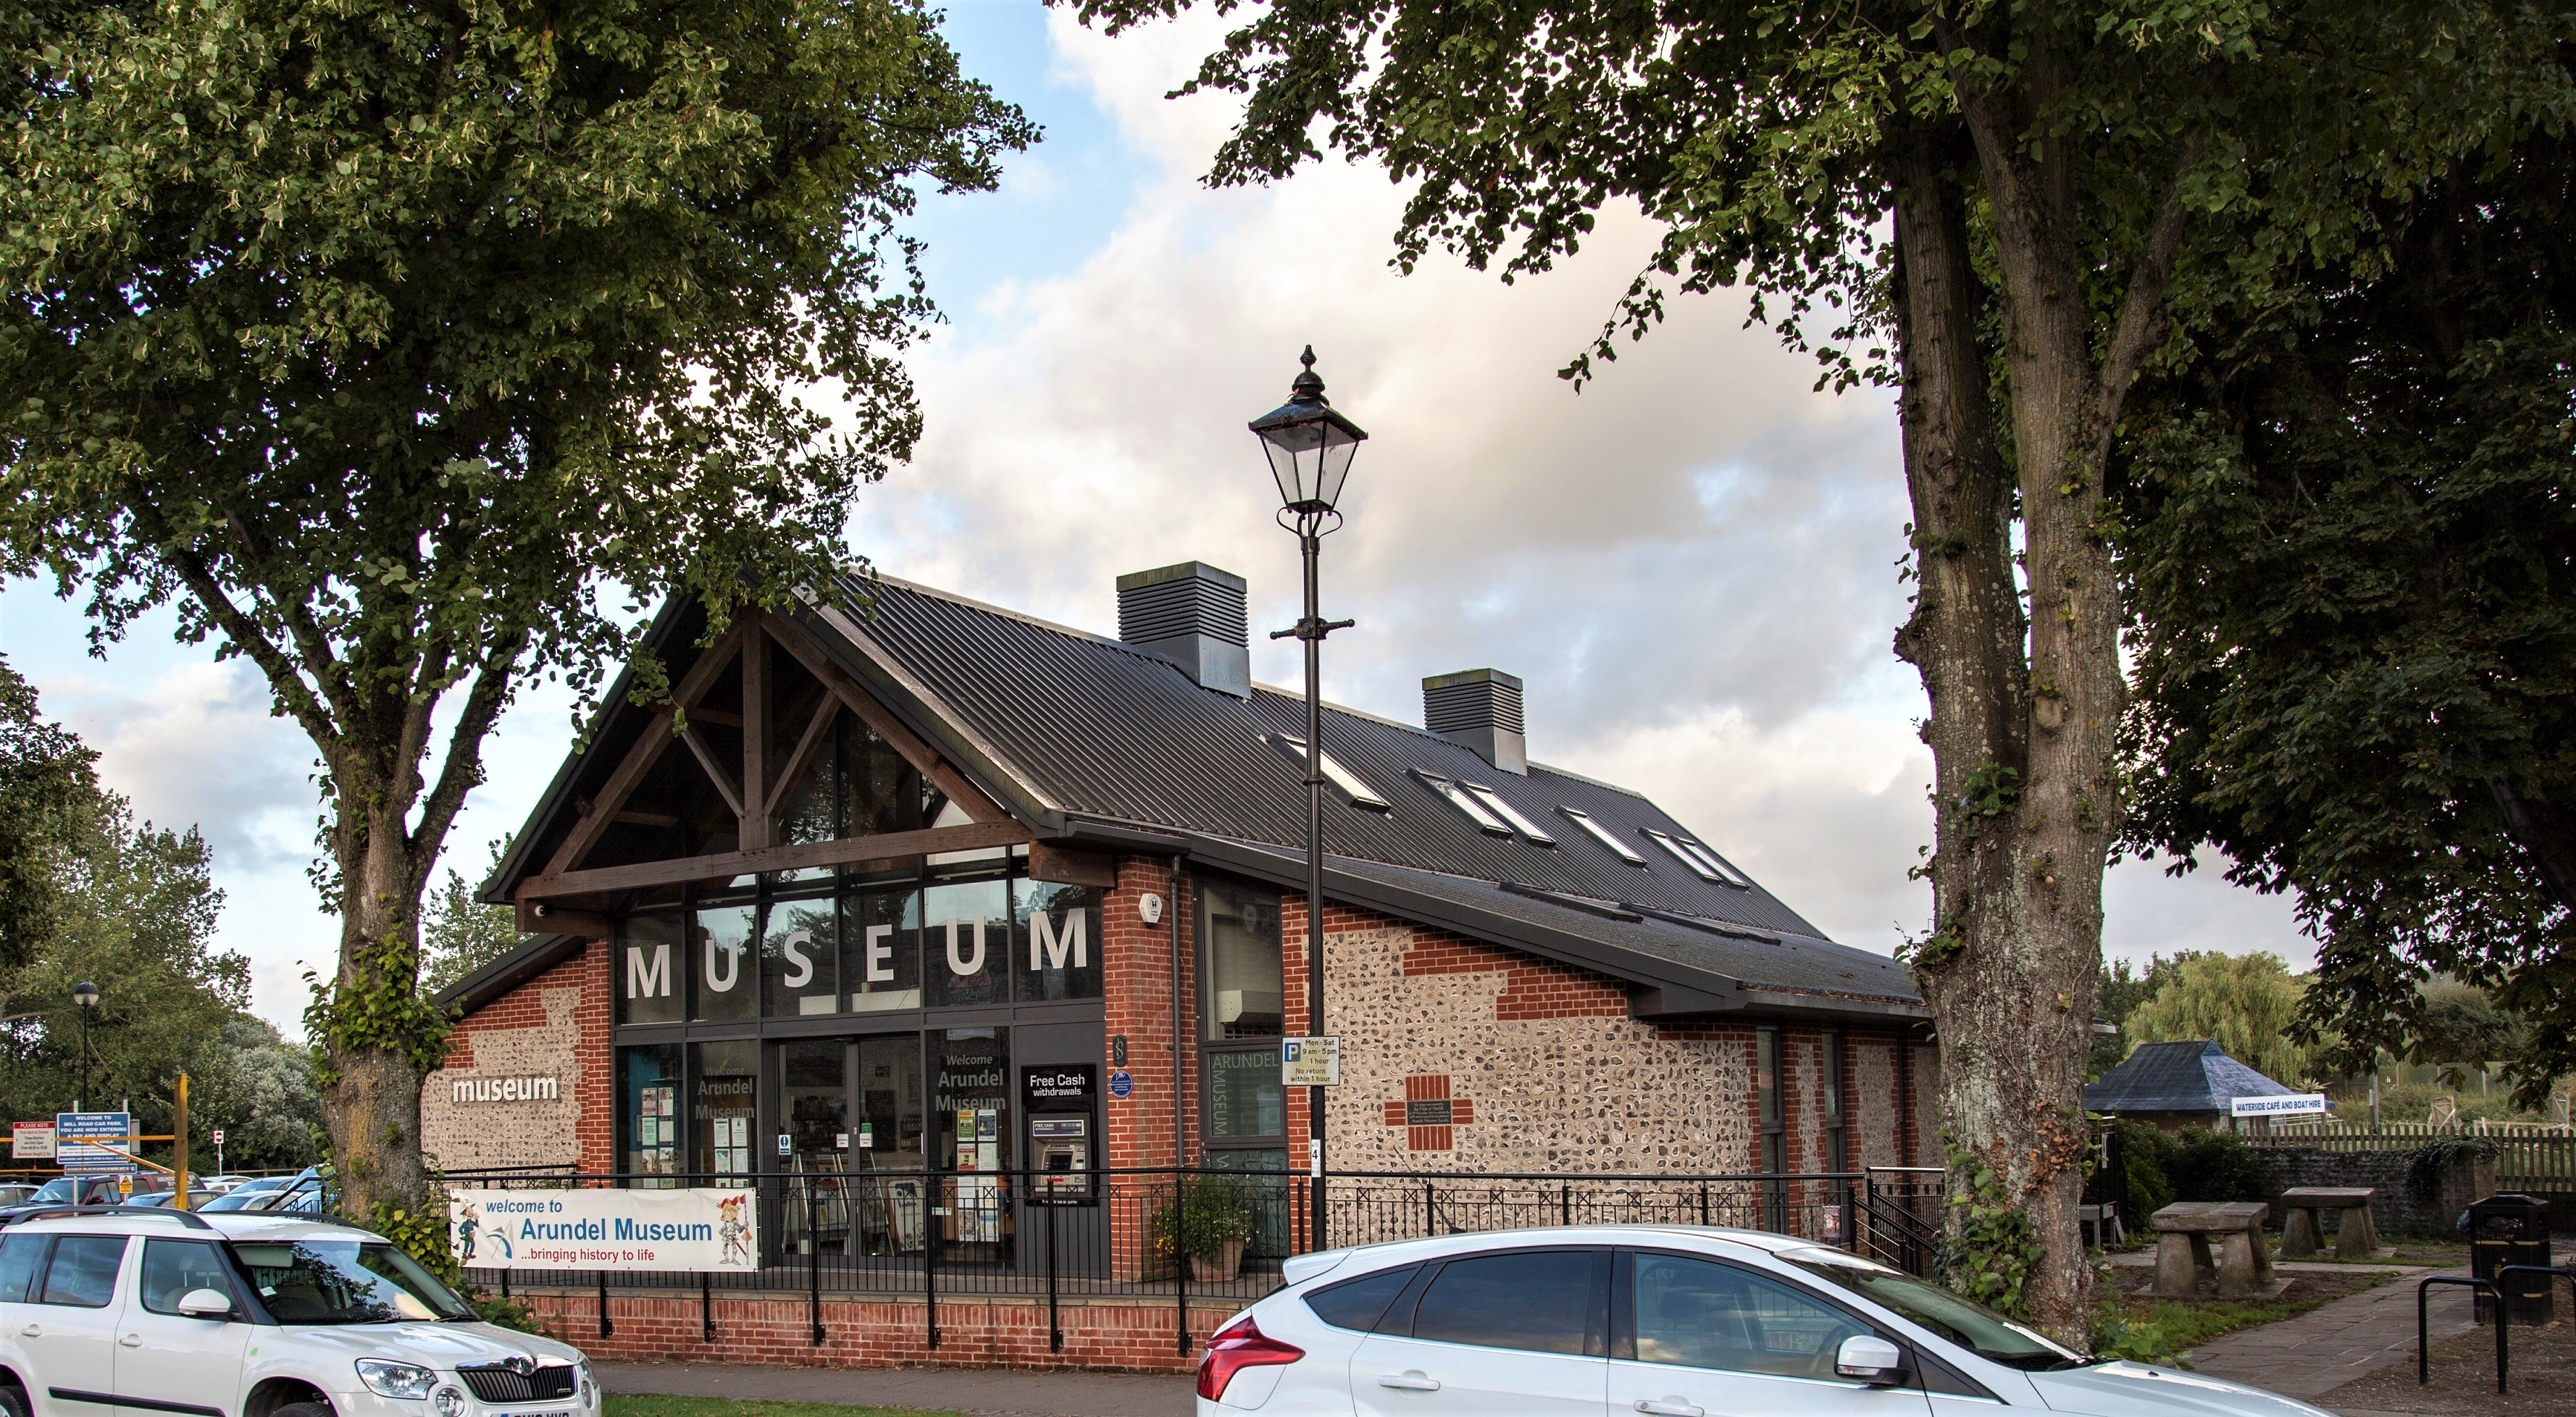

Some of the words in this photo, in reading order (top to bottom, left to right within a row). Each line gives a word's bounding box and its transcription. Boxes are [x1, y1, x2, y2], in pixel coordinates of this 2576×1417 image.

[627, 908, 1087, 998] MUSEUM
[946, 1054, 993, 1066] Welcome
[1212, 1053, 1279, 1069] ARUNDEL
[706, 1066, 745, 1076] Welcome
[937, 1068, 1003, 1087] Arundel
[698, 1077, 753, 1095] Arundel
[1030, 1075, 1055, 1087] Free
[1057, 1074, 1085, 1086] Cash
[453, 1077, 558, 1102] museum
[1033, 1087, 1082, 1097] withdrawals
[935, 1095, 1006, 1111] Museum
[1213, 1070, 1228, 1137] MUSEUM
[2236, 1103, 2265, 1111] WATERSIDE
[2266, 1100, 2280, 1110] CAFÉ
[695, 1105, 755, 1119] Museum
[1312, 1149, 1318, 1160] 4
[486, 1199, 545, 1213] welcome
[549, 1200, 562, 1213] to
[520, 1218, 606, 1240] Arundel
[615, 1218, 712, 1241] Museum
[521, 1248, 577, 1262] ...bringing
[580, 1248, 619, 1263] history
[622, 1250, 634, 1261] to
[637, 1248, 655, 1261] life
